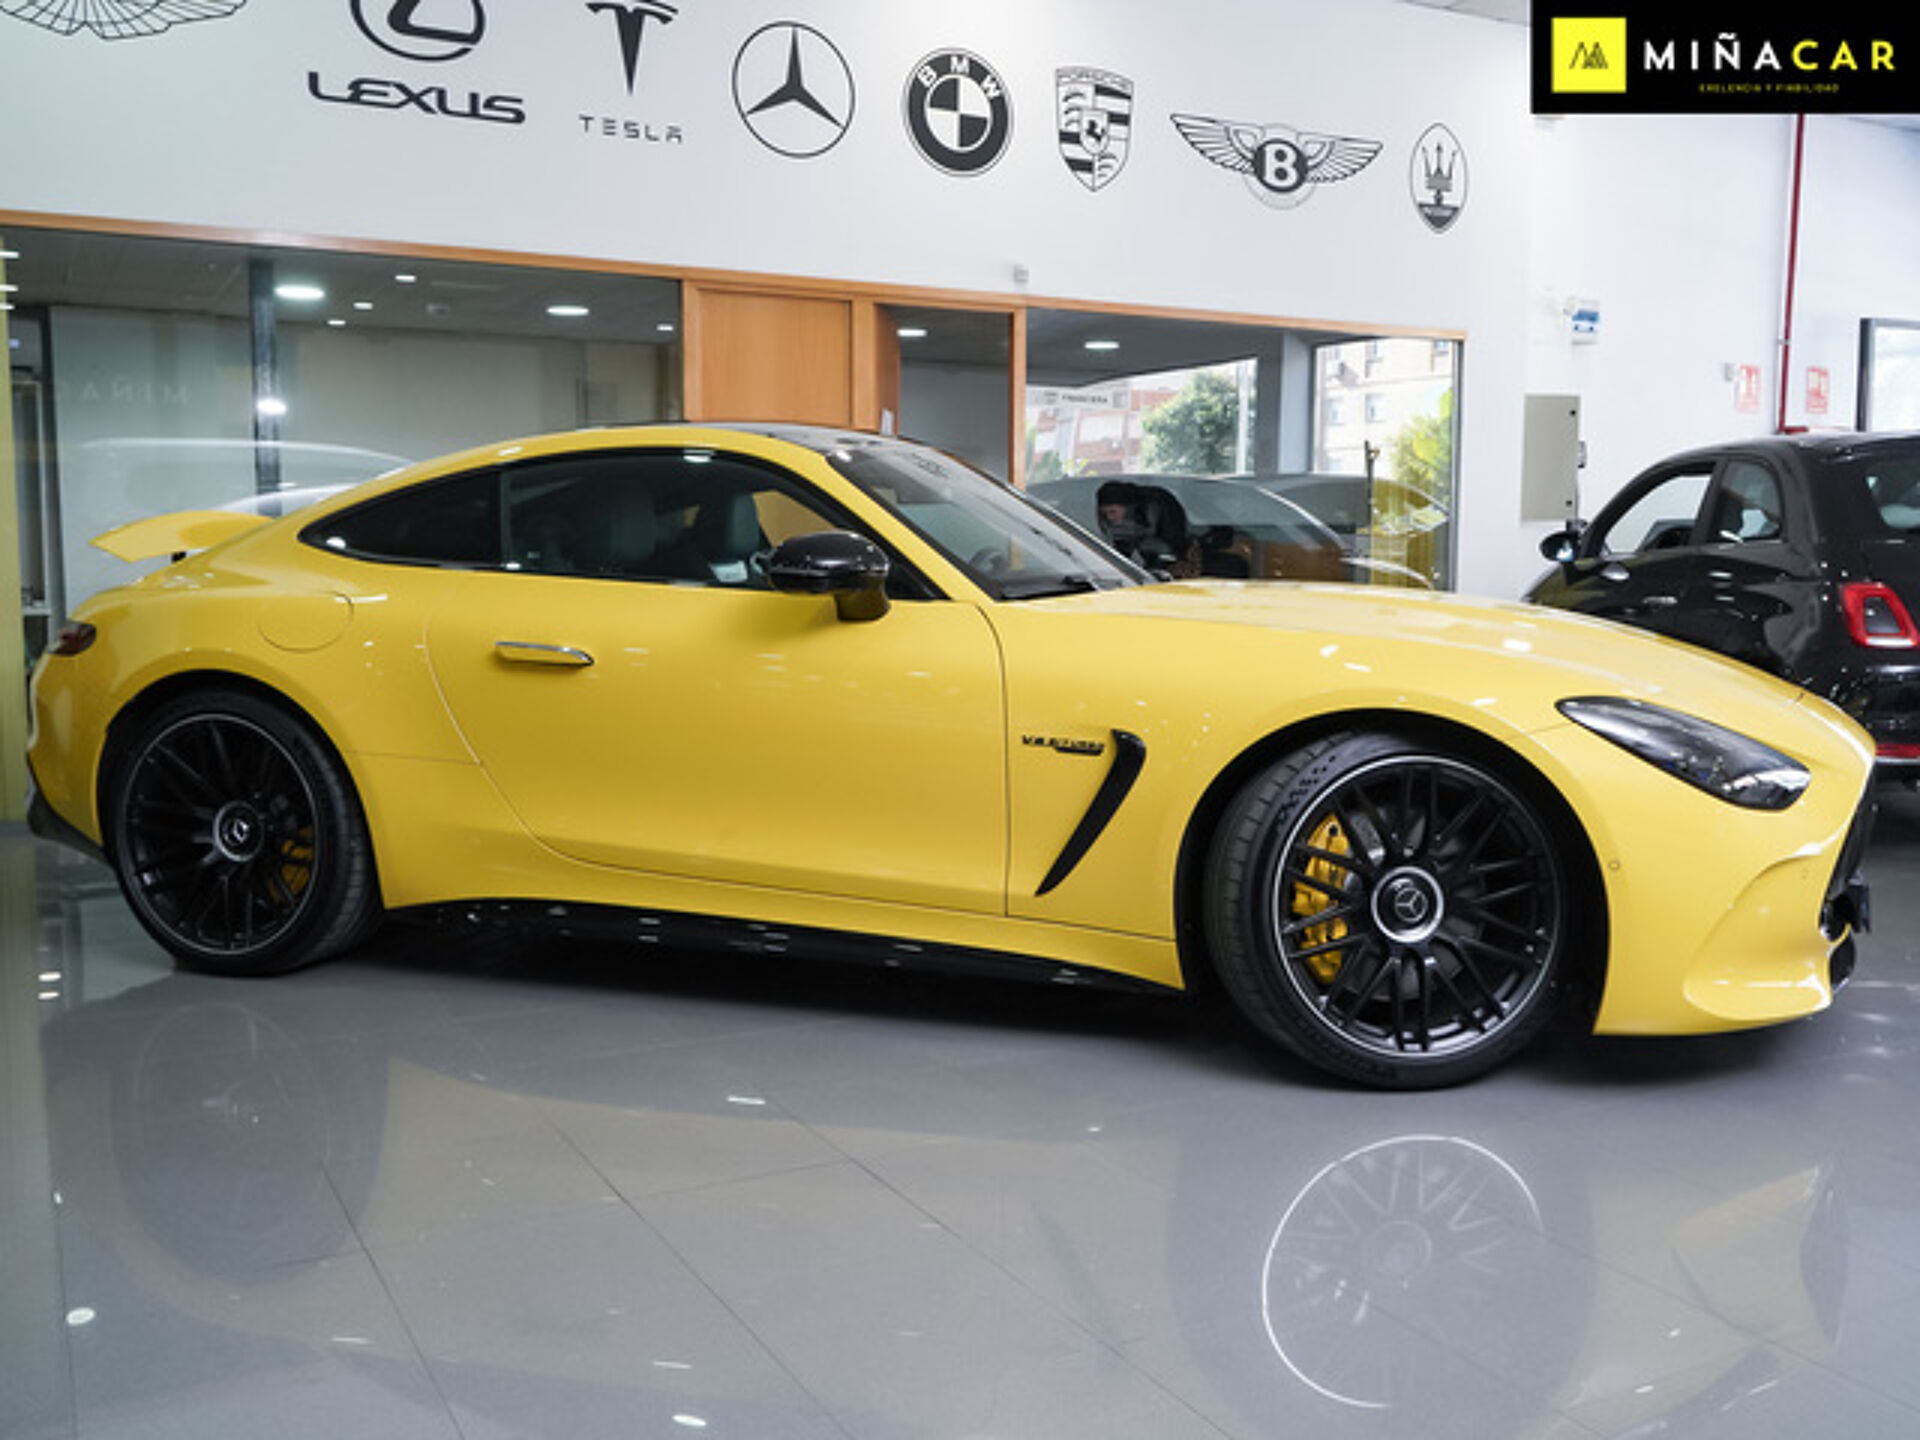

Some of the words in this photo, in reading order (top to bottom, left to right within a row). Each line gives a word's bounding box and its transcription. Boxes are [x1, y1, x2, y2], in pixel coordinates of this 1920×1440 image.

[308, 71, 526, 124] LEXUS
[917, 55, 1002, 99] BMW
[579, 114, 683, 144] TESLA
[1264, 142, 1299, 188] B
